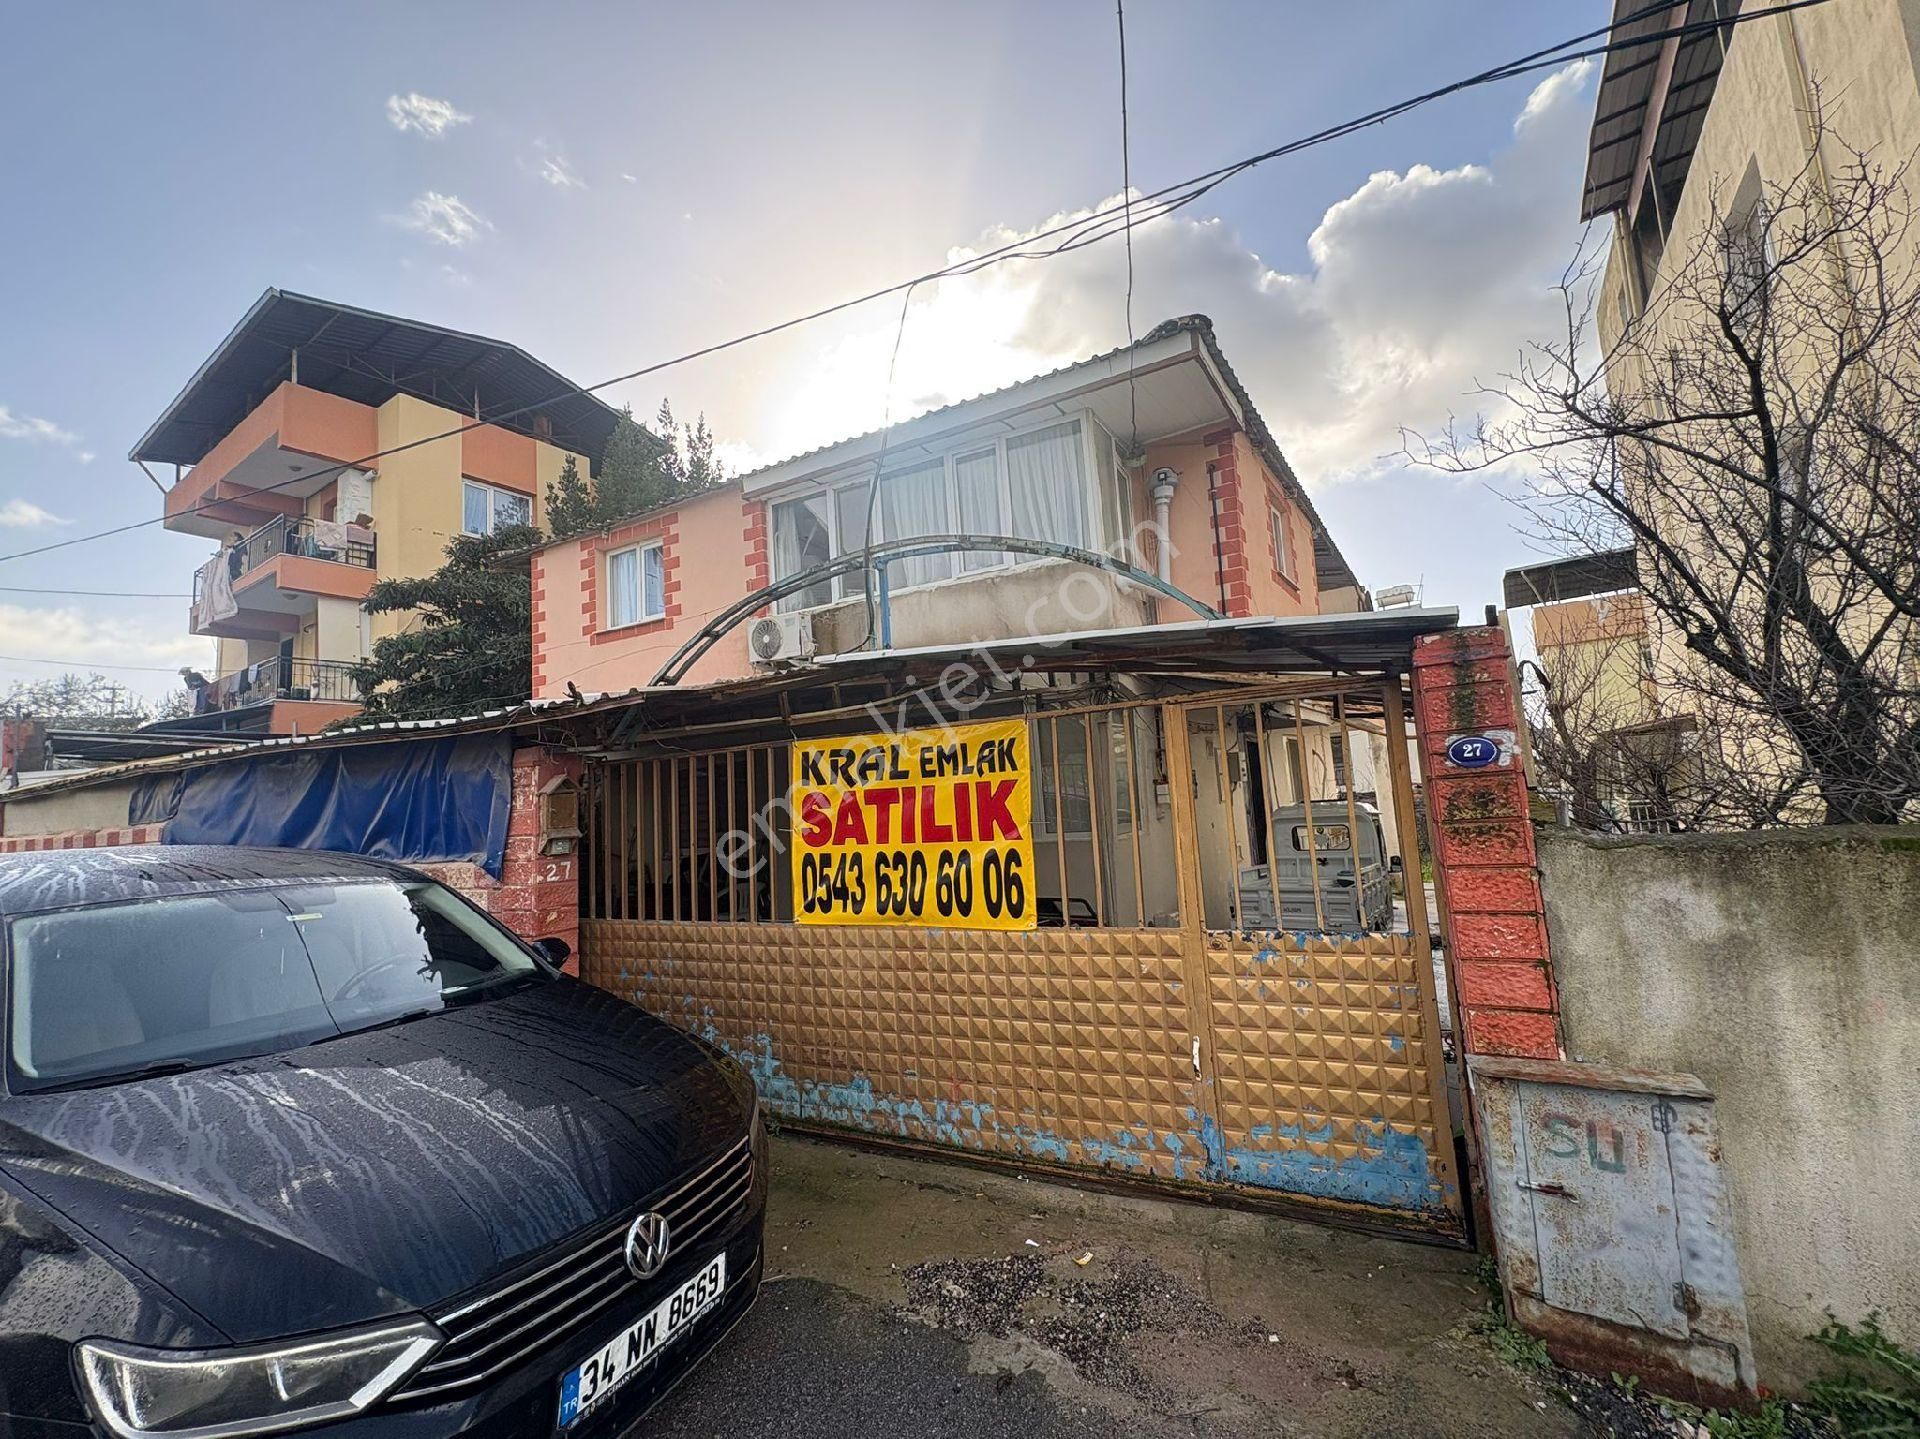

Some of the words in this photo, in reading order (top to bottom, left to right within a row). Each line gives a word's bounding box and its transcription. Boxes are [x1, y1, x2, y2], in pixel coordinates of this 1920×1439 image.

[801, 744, 910, 788] KRAL
[920, 737, 1018, 778] EMLAK
[1462, 743, 1482, 758] 27
[801, 778, 1024, 848] SATILIK
[546, 861, 572, 882] 27
[801, 850, 866, 916] 0543
[875, 849, 928, 917] 630
[936, 848, 973, 918] 60
[982, 847, 1025, 919] 06
[1541, 1111, 1627, 1175] SU
[563, 1396, 578, 1414] TR
[582, 1358, 616, 1403] 34
[626, 1312, 658, 1370] NN
[668, 1262, 719, 1331] 8669
